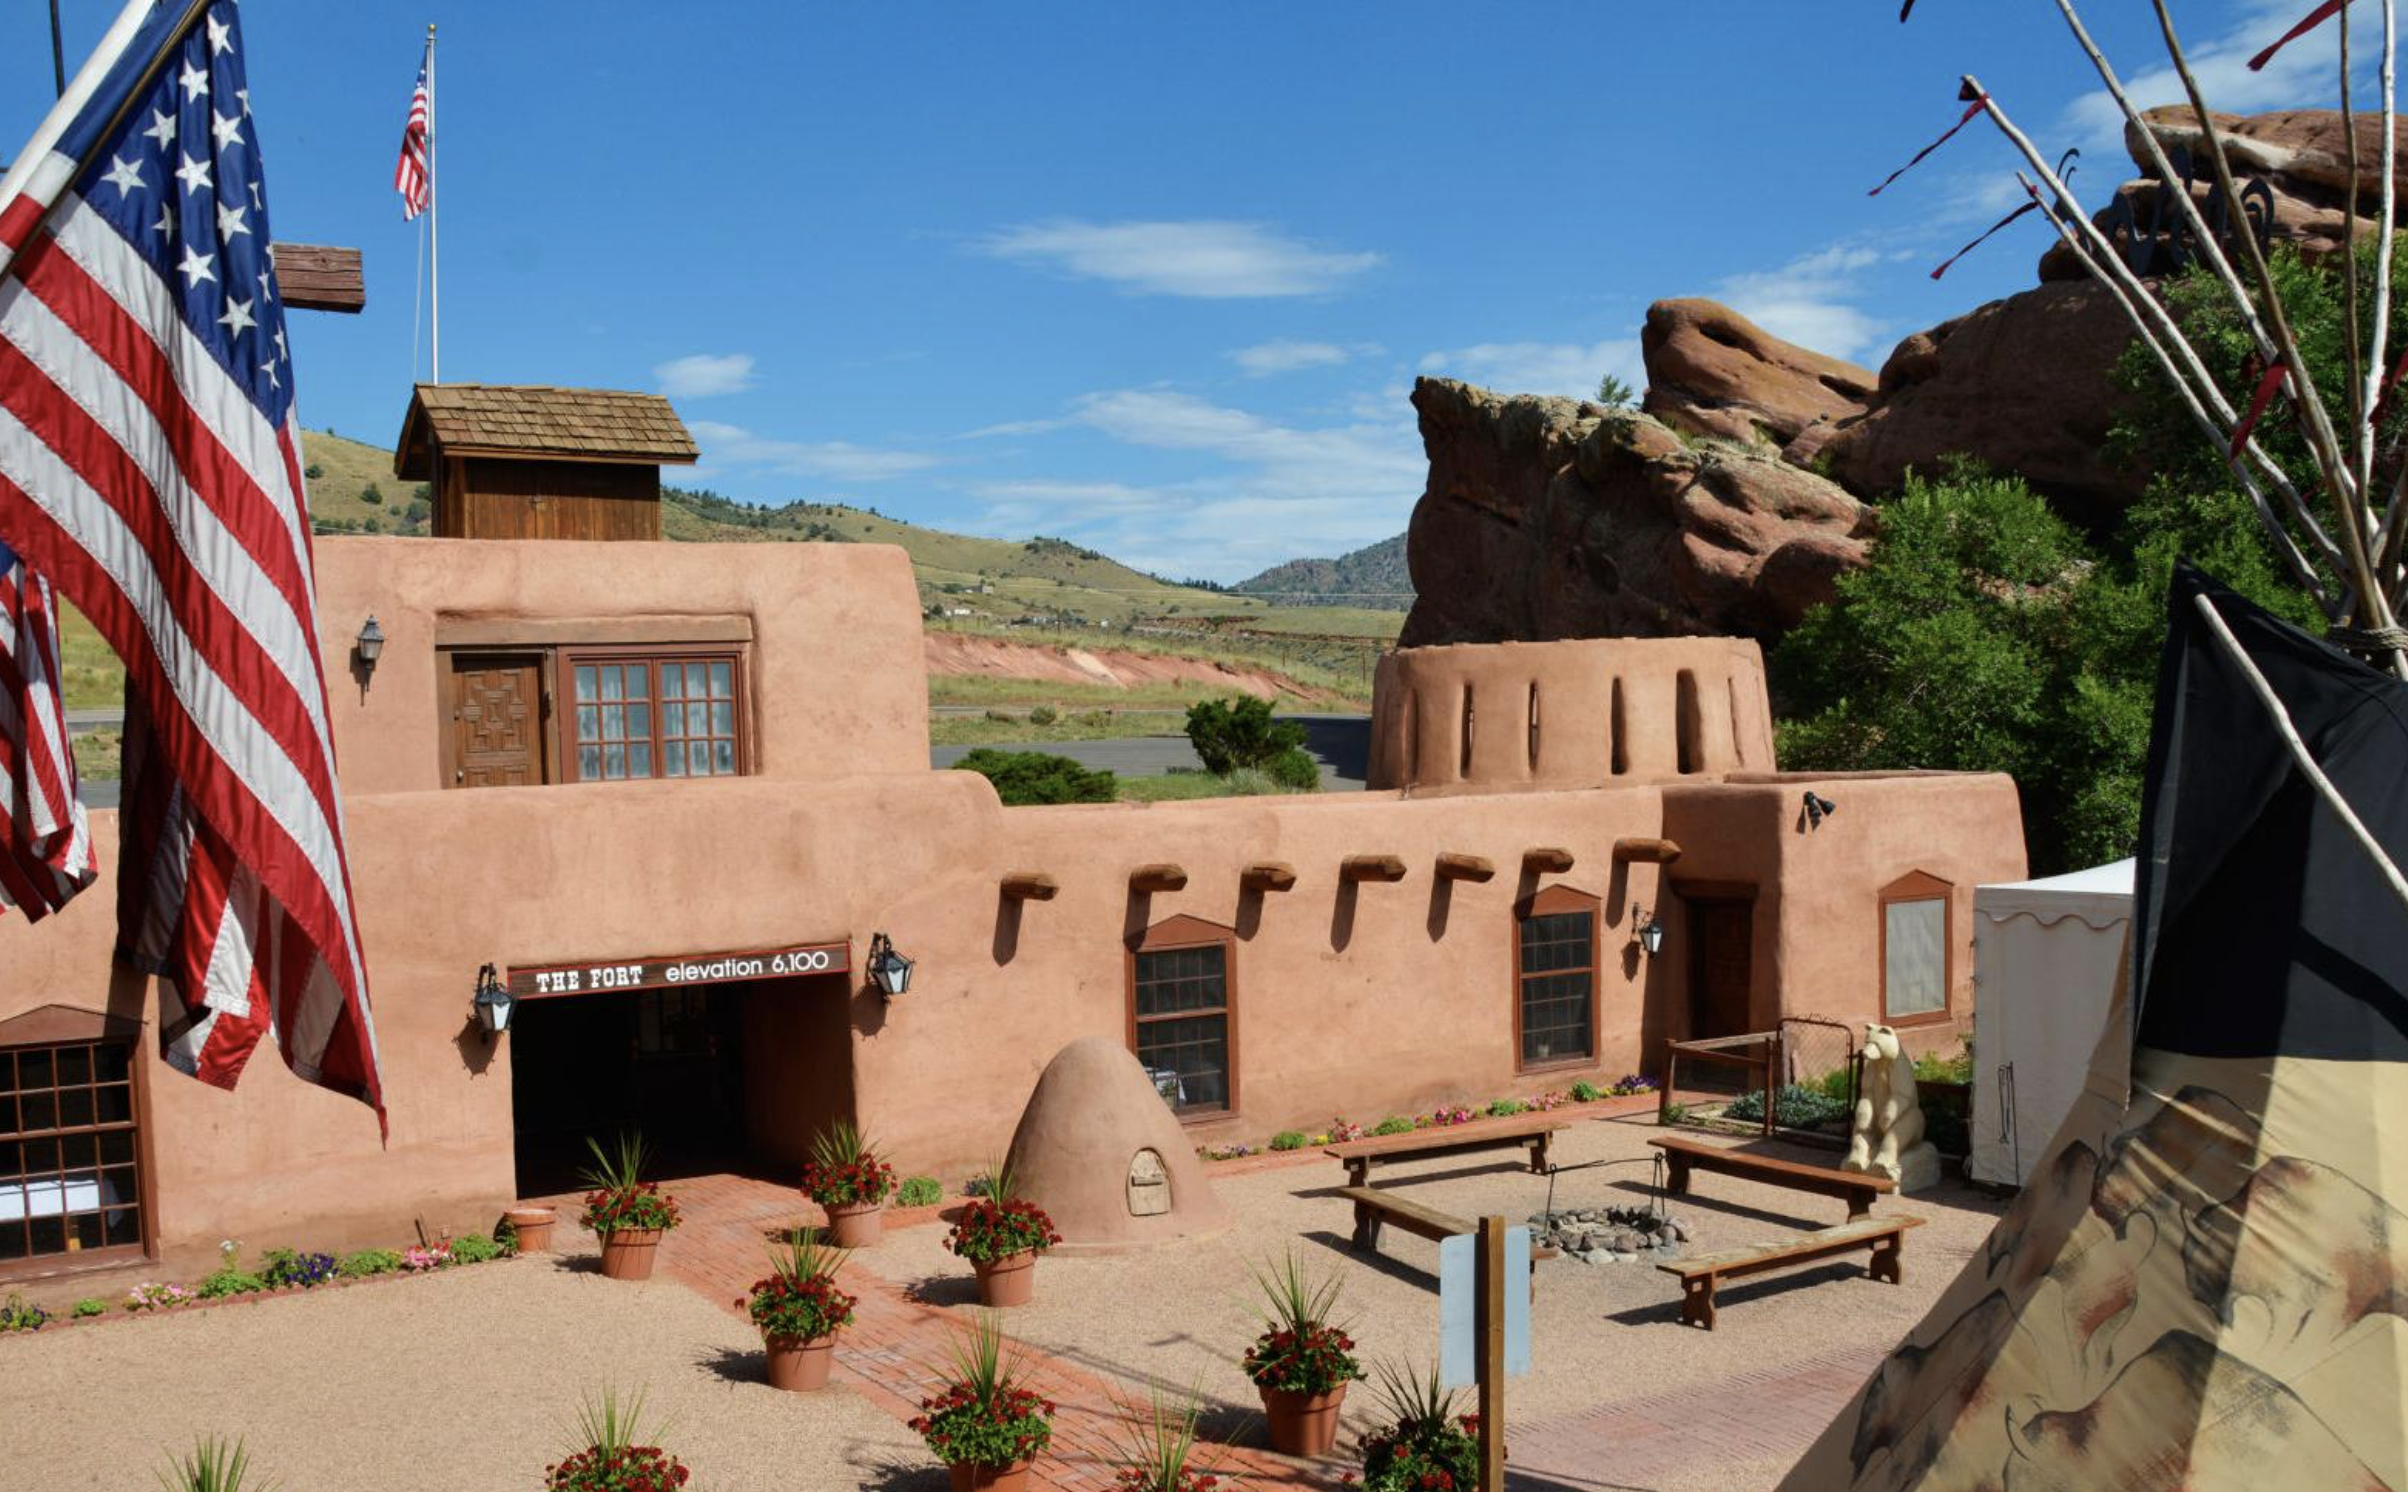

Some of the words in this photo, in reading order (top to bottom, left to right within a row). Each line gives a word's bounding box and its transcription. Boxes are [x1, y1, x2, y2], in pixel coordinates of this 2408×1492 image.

[536, 970, 580, 993] THE
[589, 965, 643, 989] FORT
[665, 958, 763, 982] elevation
[771, 951, 829, 974] 6,100
